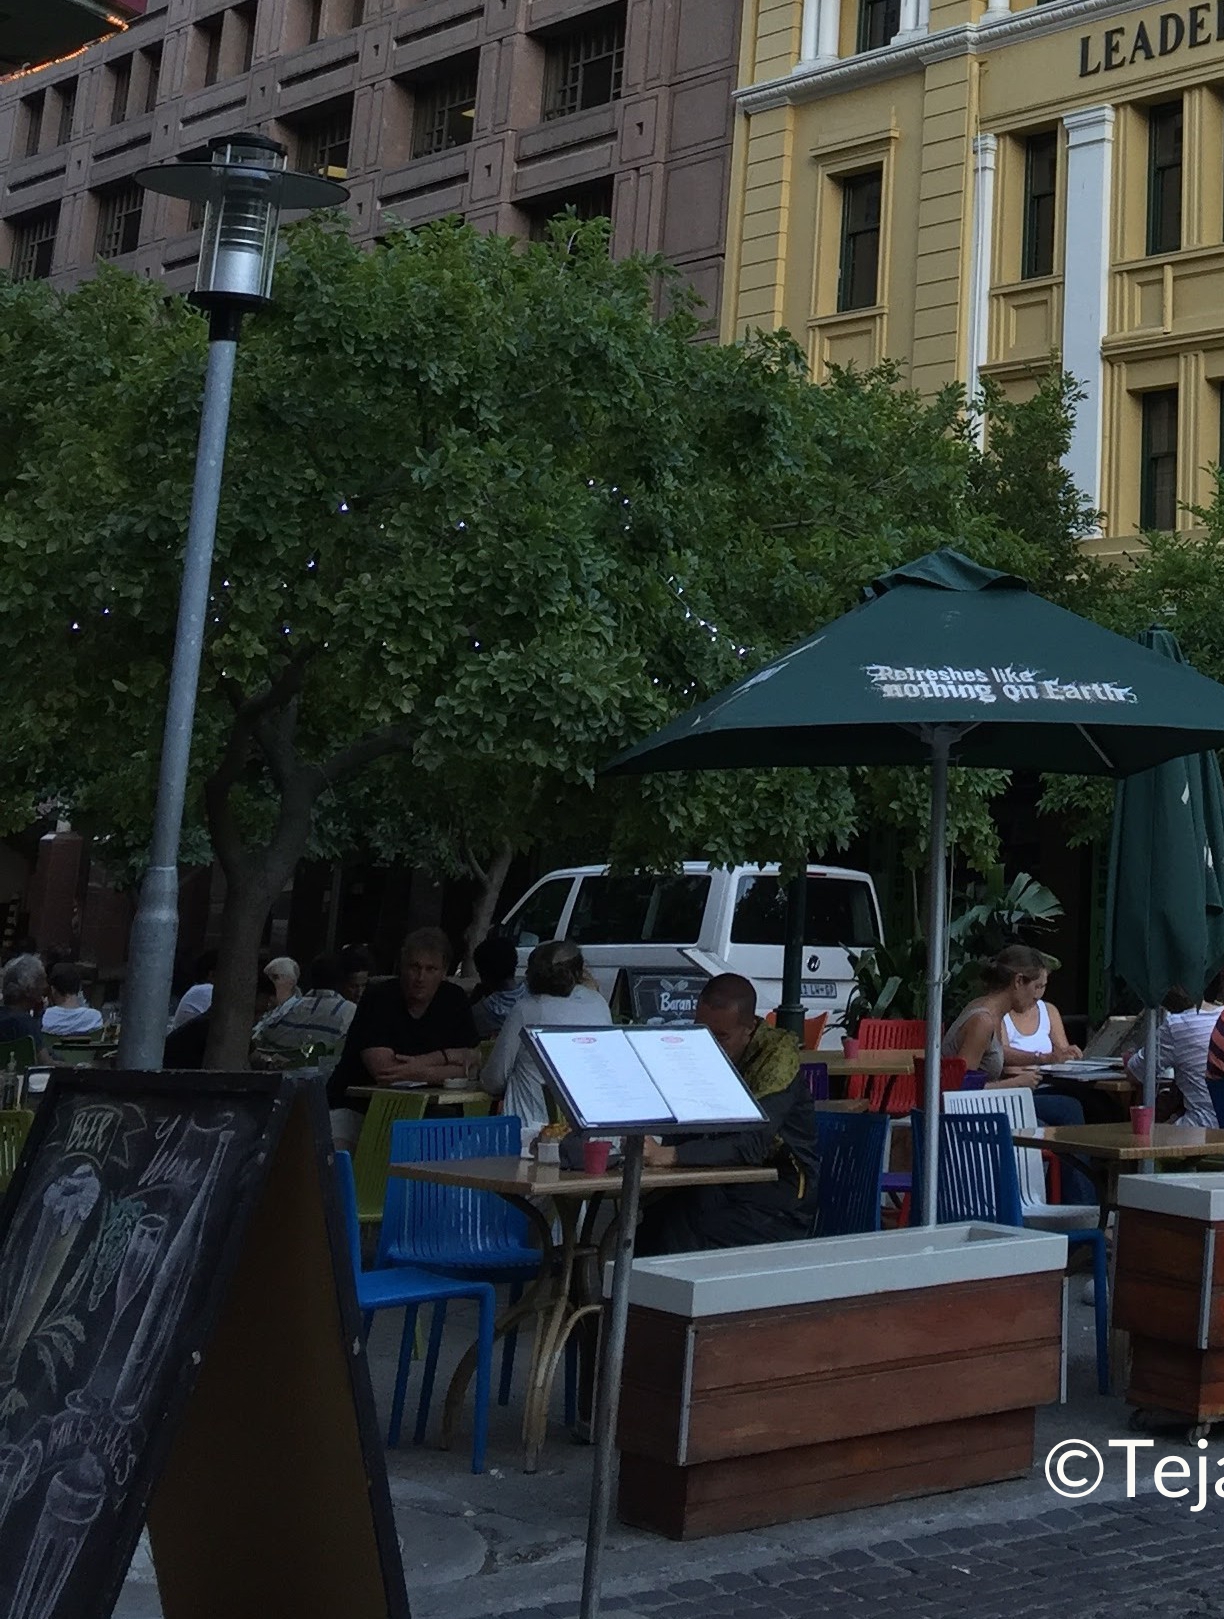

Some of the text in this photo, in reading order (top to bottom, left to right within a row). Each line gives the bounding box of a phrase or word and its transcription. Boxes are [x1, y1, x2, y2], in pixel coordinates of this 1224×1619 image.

[866, 662, 1038, 684] Refreshes like
[879, 677, 1134, 703] nothing on Earth
[64, 1110, 115, 1153] BEER
